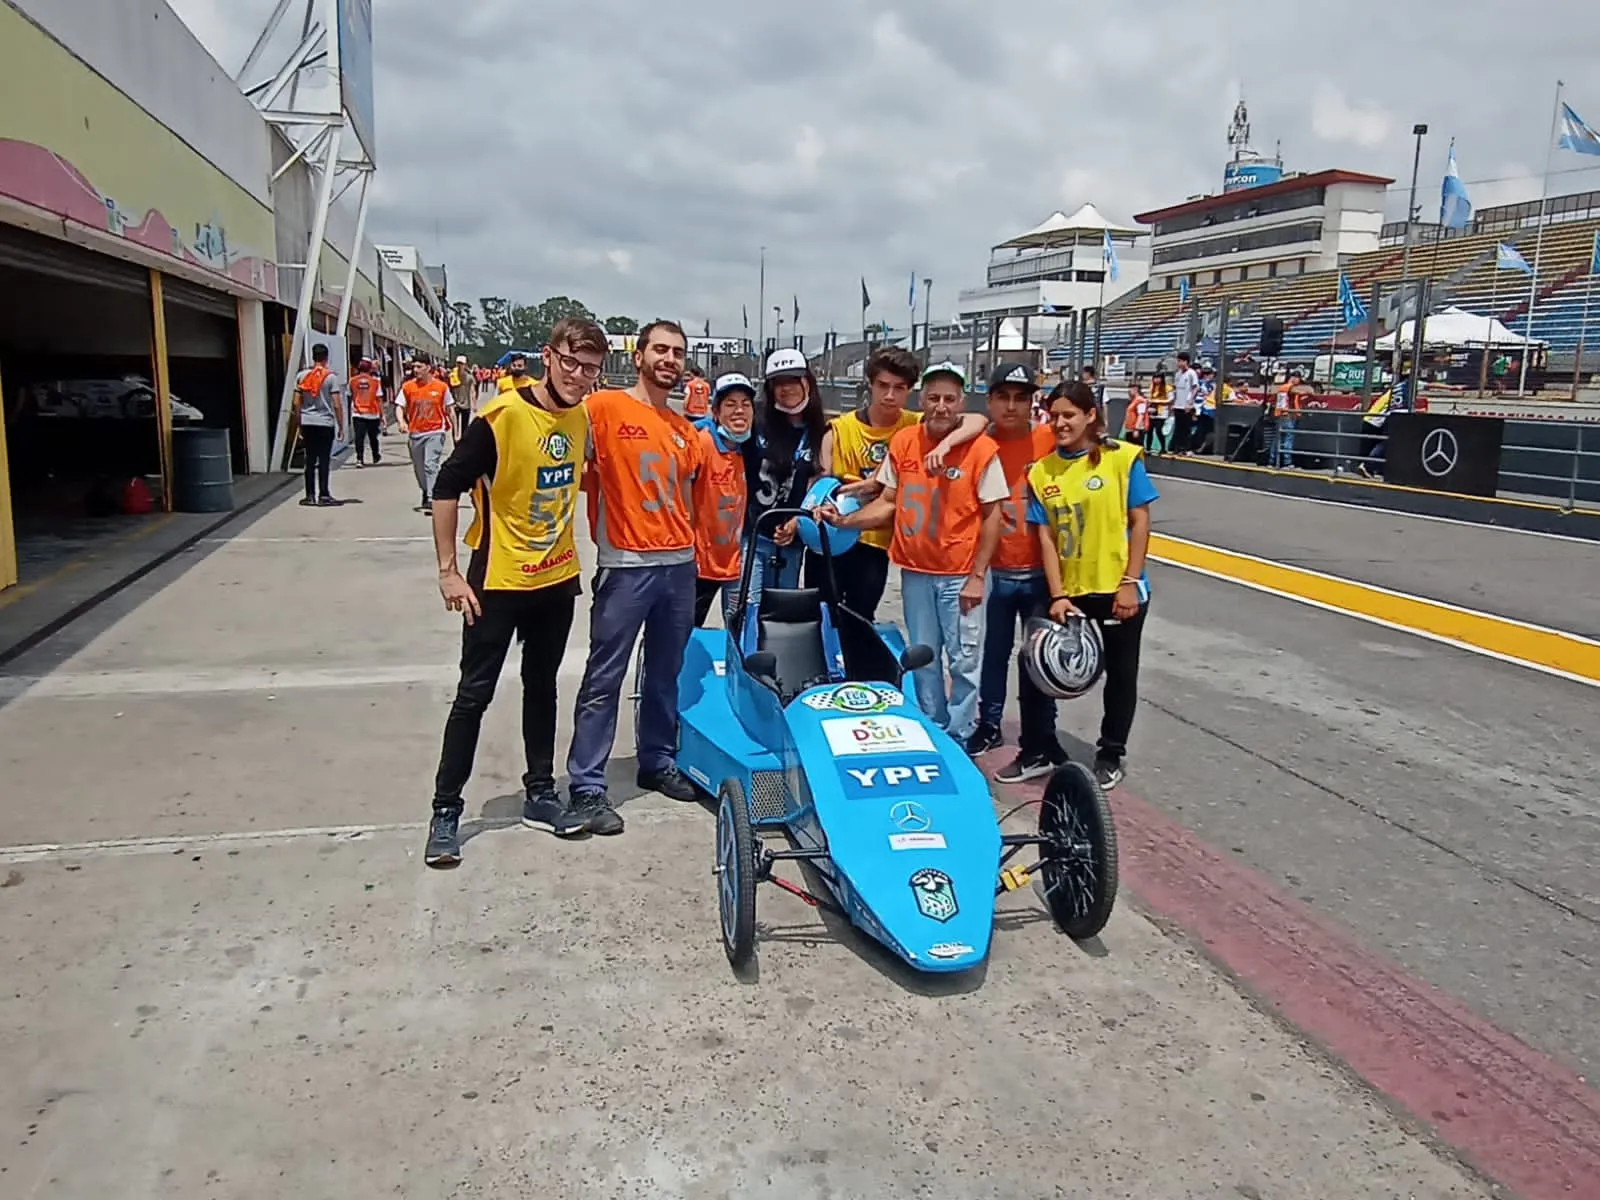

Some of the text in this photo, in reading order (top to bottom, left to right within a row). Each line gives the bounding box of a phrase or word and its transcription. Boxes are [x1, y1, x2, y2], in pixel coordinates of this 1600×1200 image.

[773, 359, 796, 368] YPF
[543, 467, 573, 483] YPF
[638, 451, 677, 514] 51
[528, 487, 570, 550] 51
[901, 482, 942, 541] 51
[1055, 503, 1084, 558] 51
[848, 764, 941, 788] YPF
